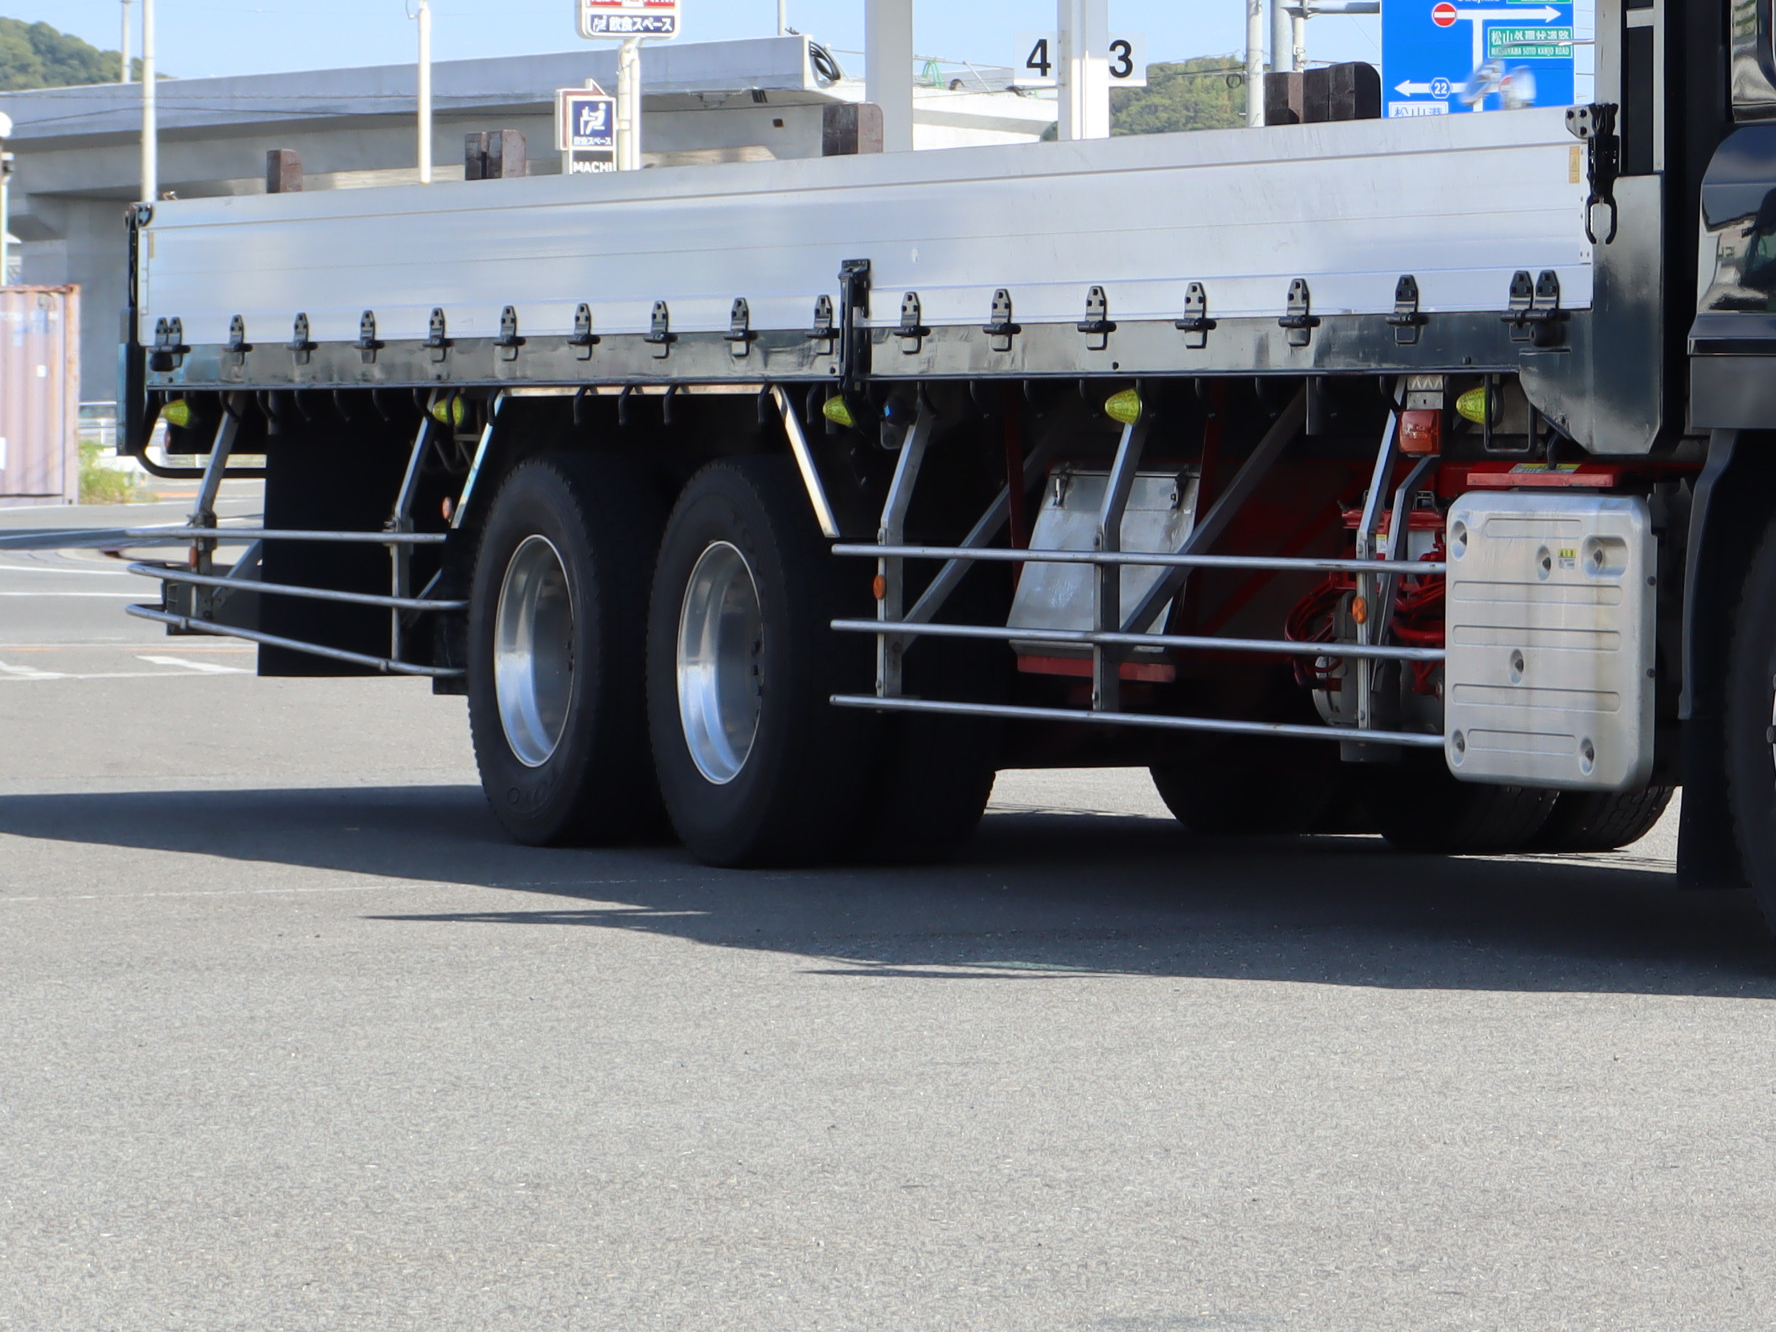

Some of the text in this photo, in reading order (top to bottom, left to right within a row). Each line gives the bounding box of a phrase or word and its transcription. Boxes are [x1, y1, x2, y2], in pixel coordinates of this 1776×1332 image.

[1026, 38, 1051, 77] 4
[1109, 39, 1133, 78] 3
[1434, 83, 1447, 94] 22
